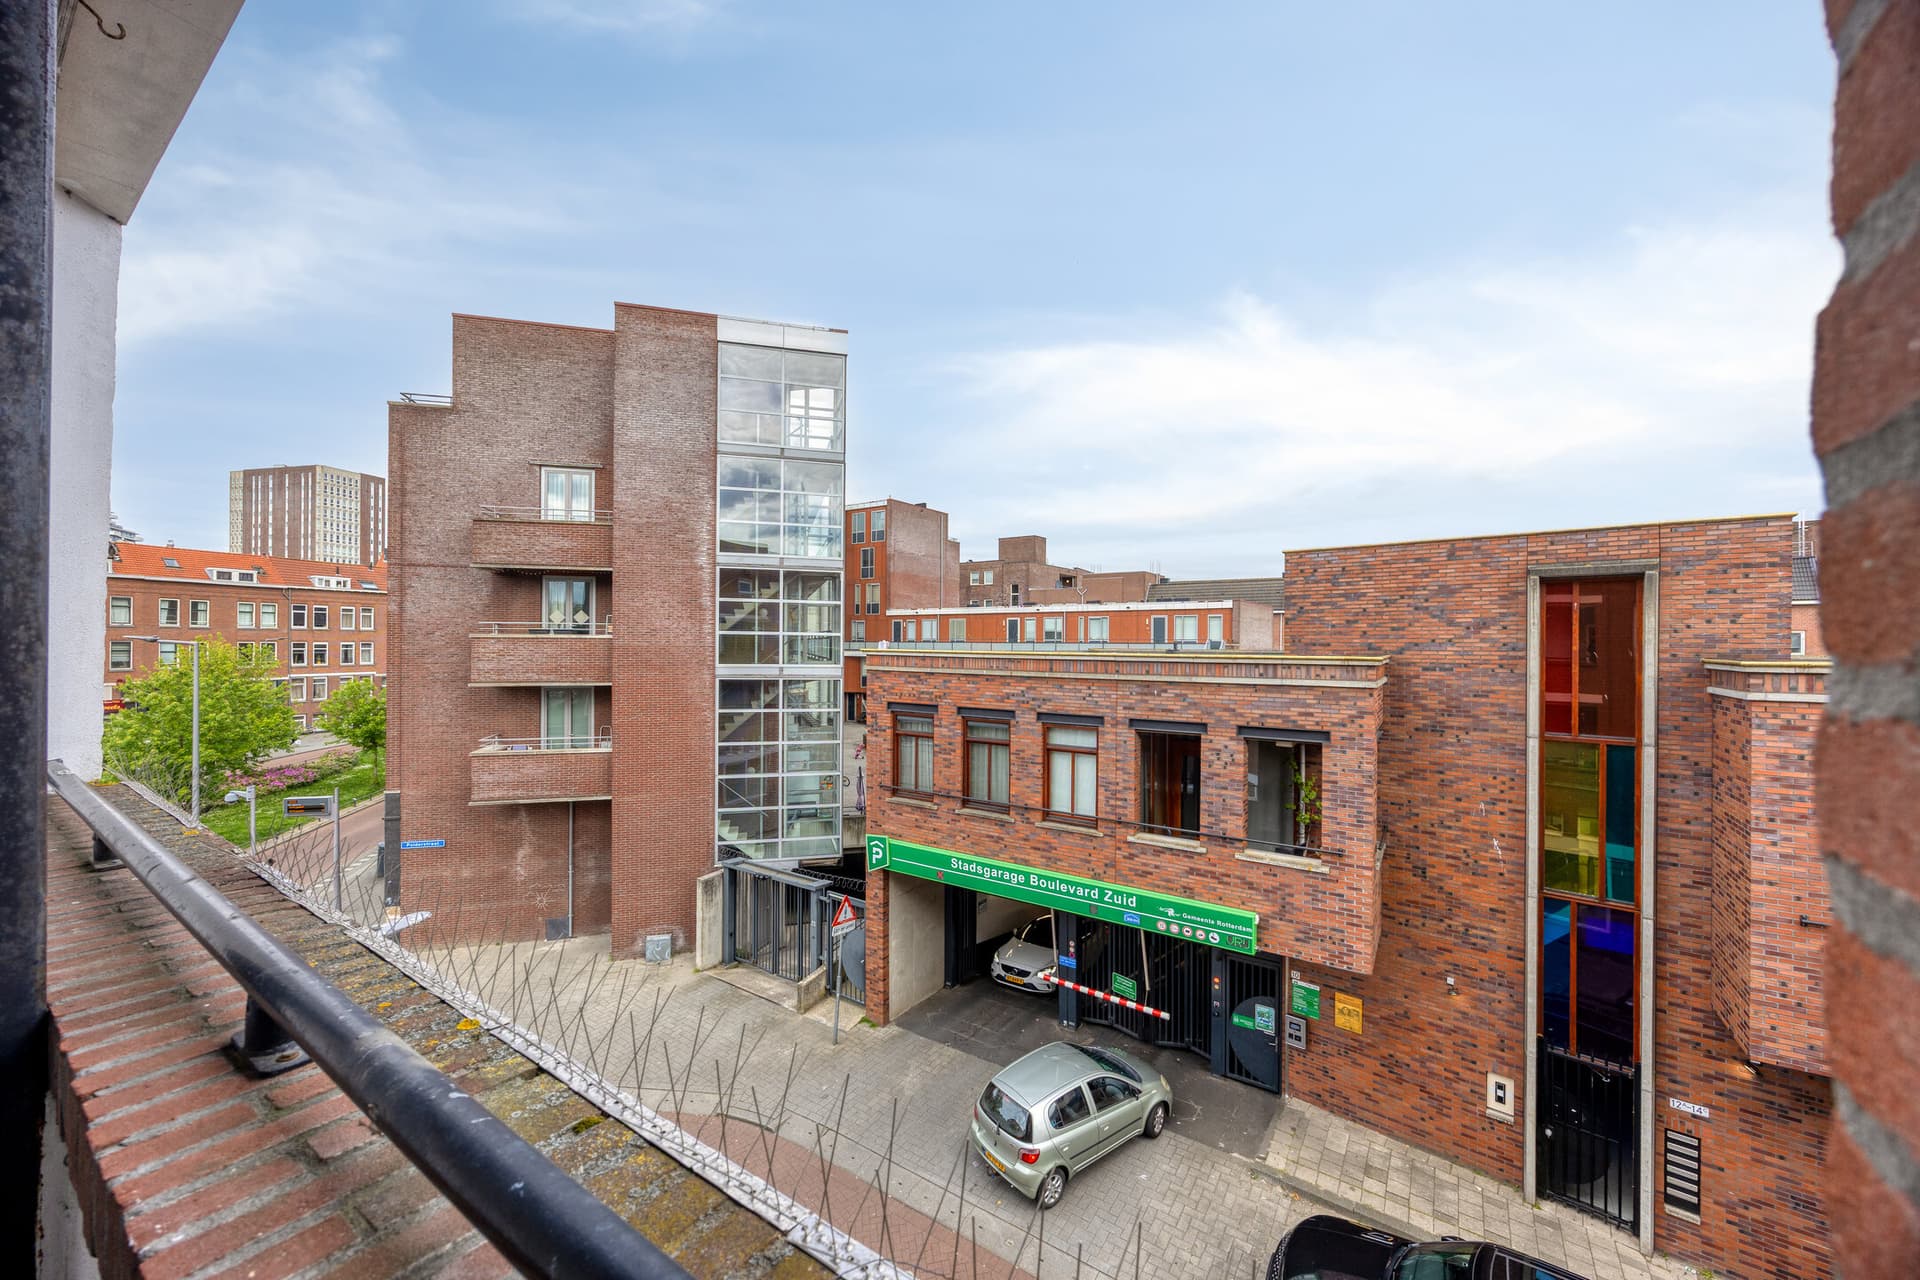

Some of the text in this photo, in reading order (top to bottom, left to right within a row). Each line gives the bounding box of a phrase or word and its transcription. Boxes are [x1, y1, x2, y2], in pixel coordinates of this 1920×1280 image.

[872, 847, 883, 864] P
[951, 858, 1137, 907] Stadsgarage Boulevard Zuid
[1182, 912, 1252, 932] Gemeente Rotterdam
